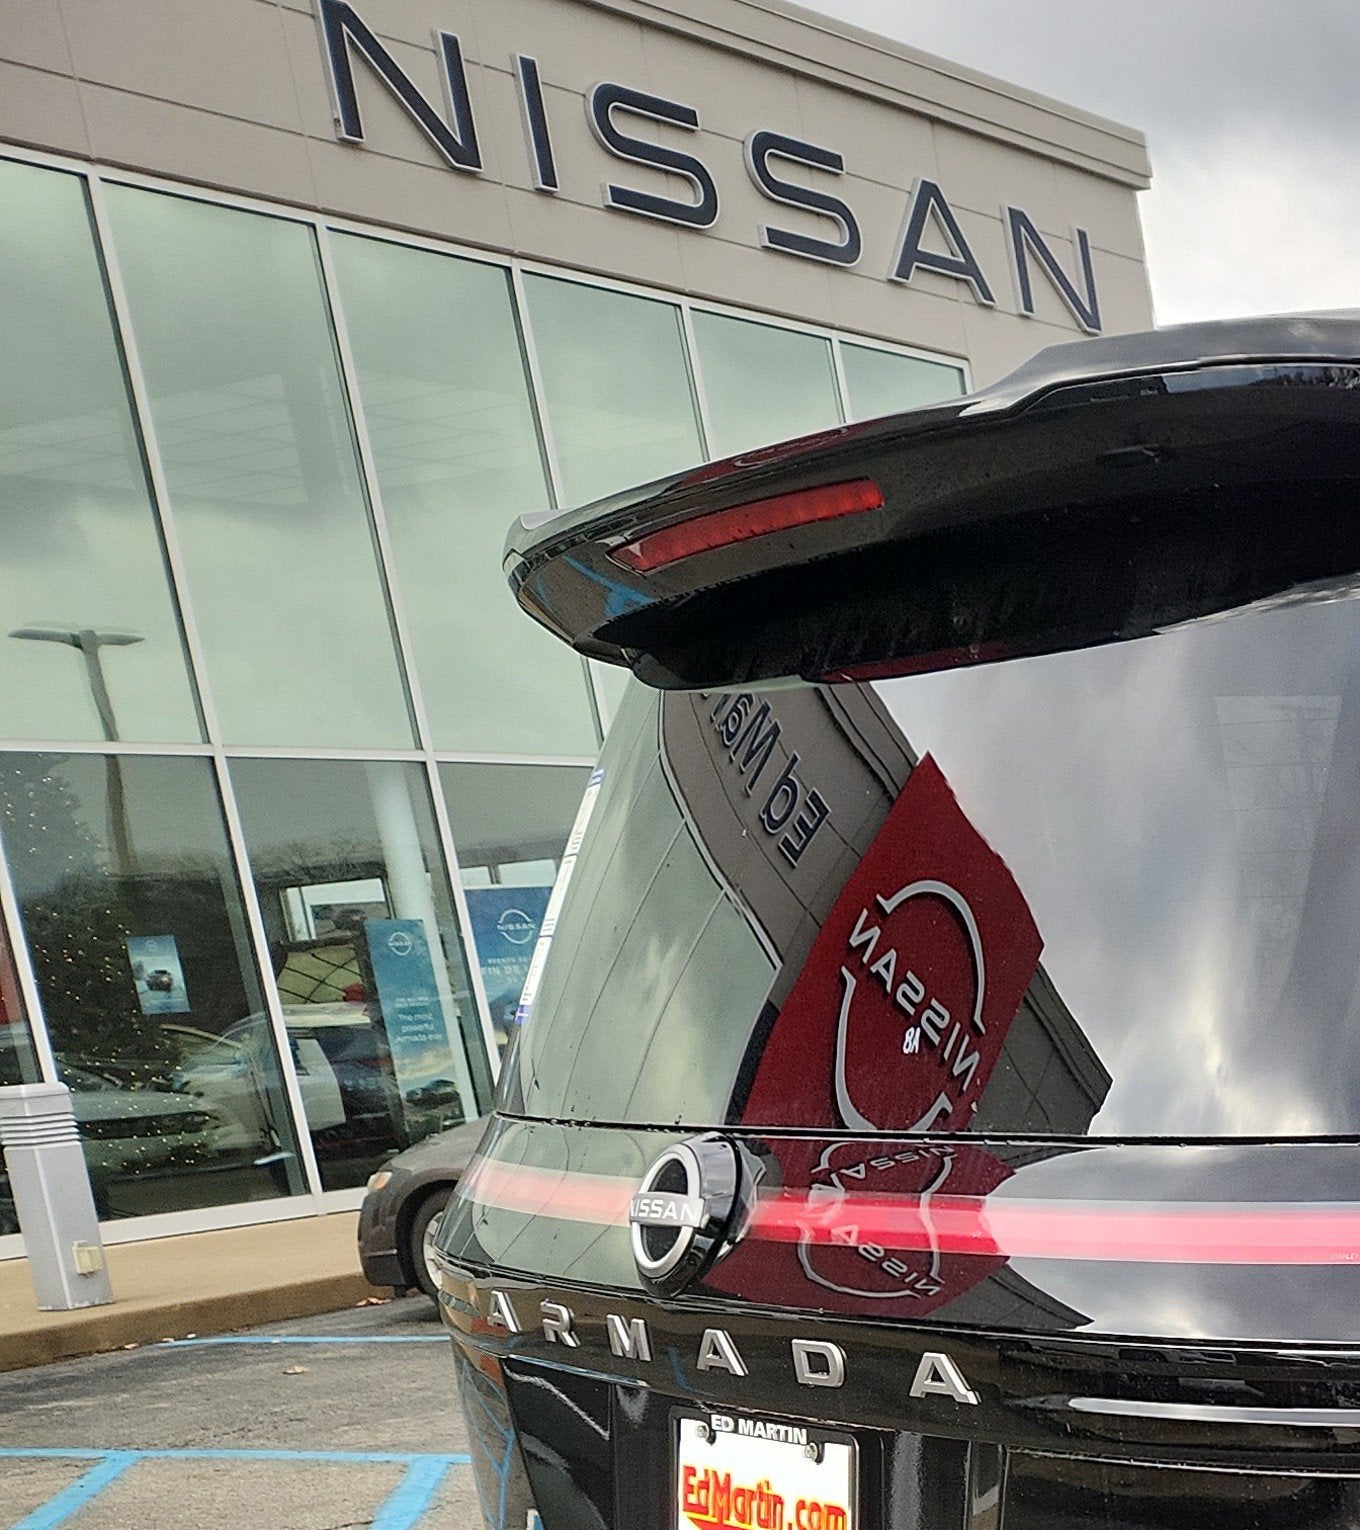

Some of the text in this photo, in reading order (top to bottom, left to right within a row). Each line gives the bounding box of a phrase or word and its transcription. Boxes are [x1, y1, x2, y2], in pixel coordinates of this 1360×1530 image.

[316, 0, 1102, 335] NISSAN
[488, 1290, 982, 1405] ARMADA
[711, 1414, 808, 1446] ED MARTIN
